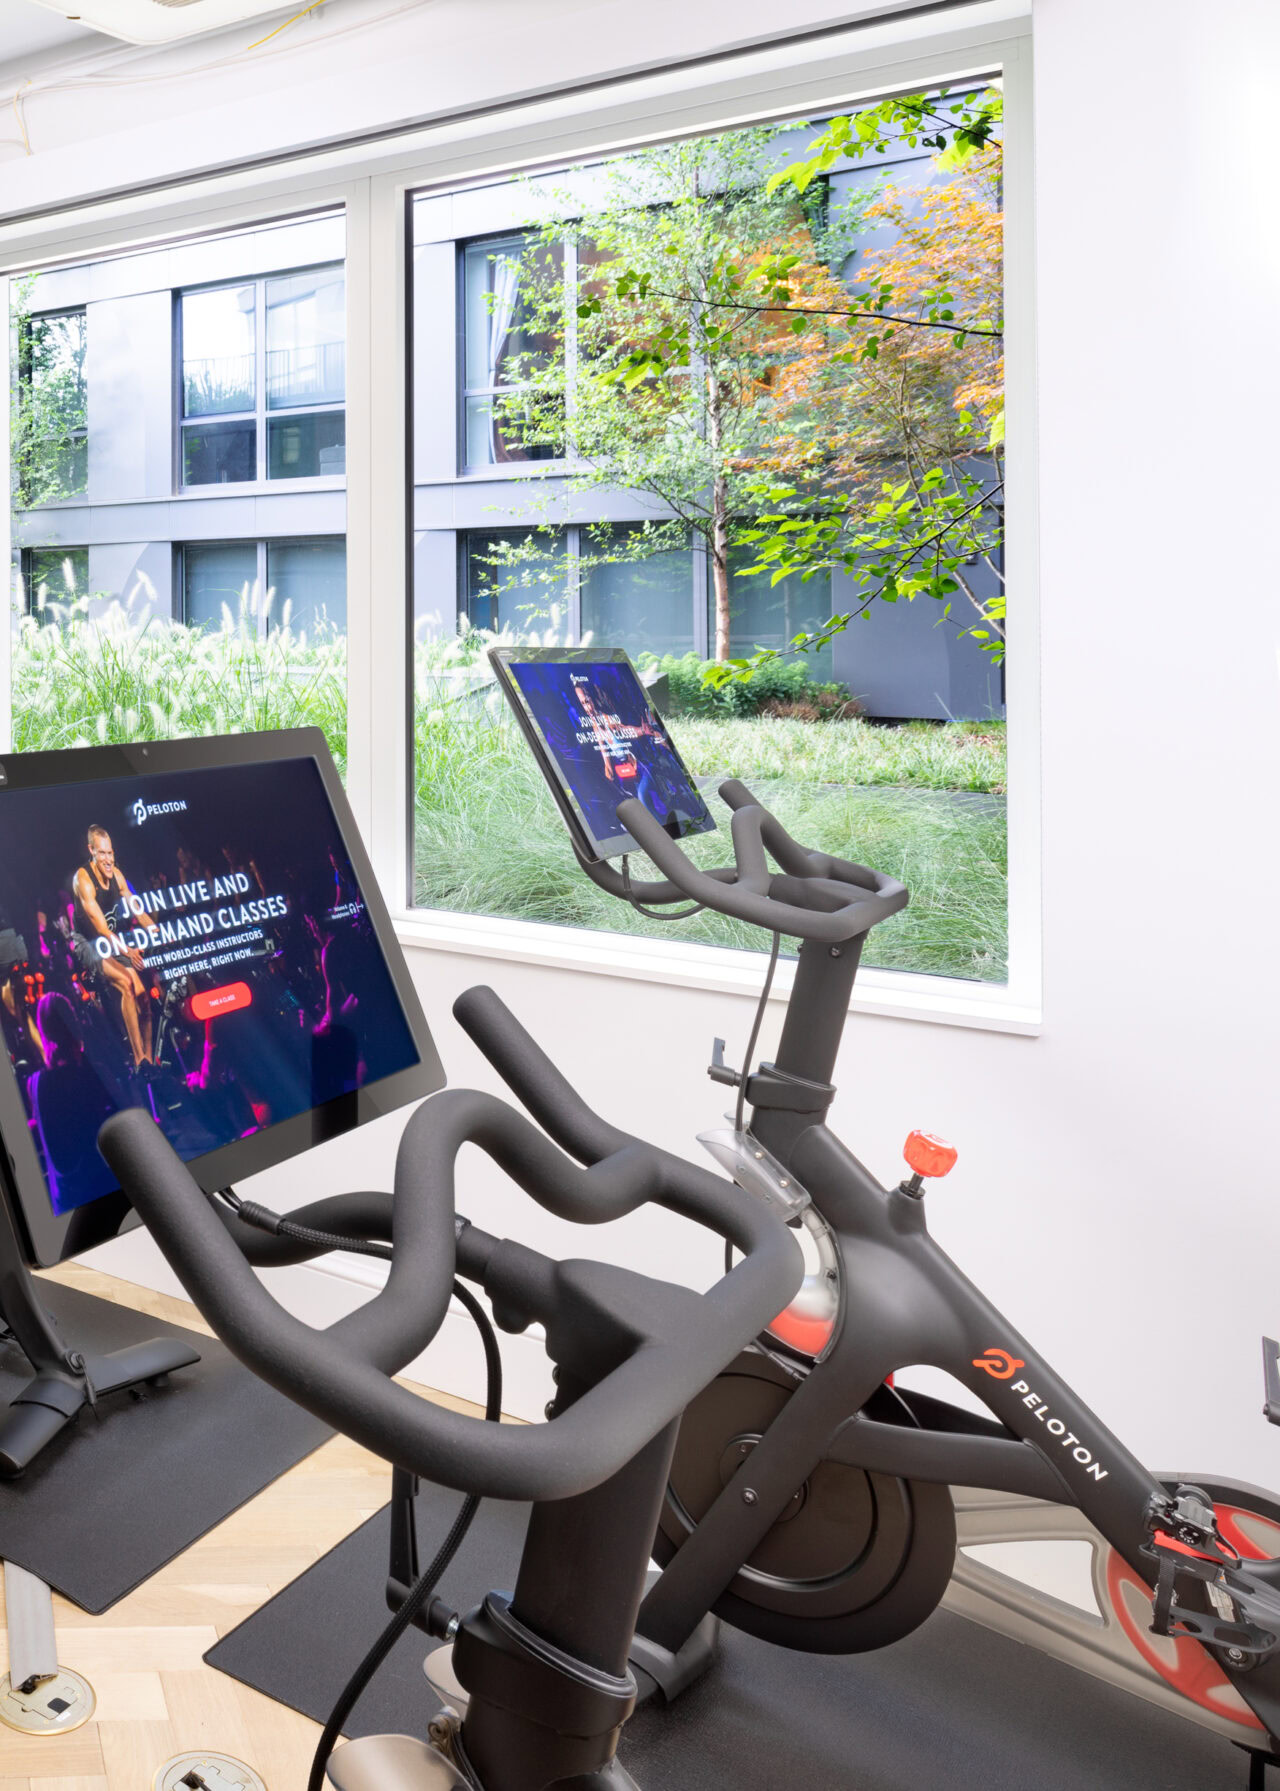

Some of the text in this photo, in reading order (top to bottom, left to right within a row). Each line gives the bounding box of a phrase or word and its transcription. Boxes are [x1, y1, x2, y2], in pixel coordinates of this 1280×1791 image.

[147, 800, 187, 815] PELOTON
[122, 872, 249, 918] JOIN LIVE AND
[95, 895, 288, 960] ON-DEMAND CLASSES
[142, 930, 264, 968] WITH WORLD-CLASS INSTRUCTORS
[164, 948, 254, 980] RIGHT HERE, RIGHT NOW.
[1010, 1380, 1110, 1482] PELOTON
